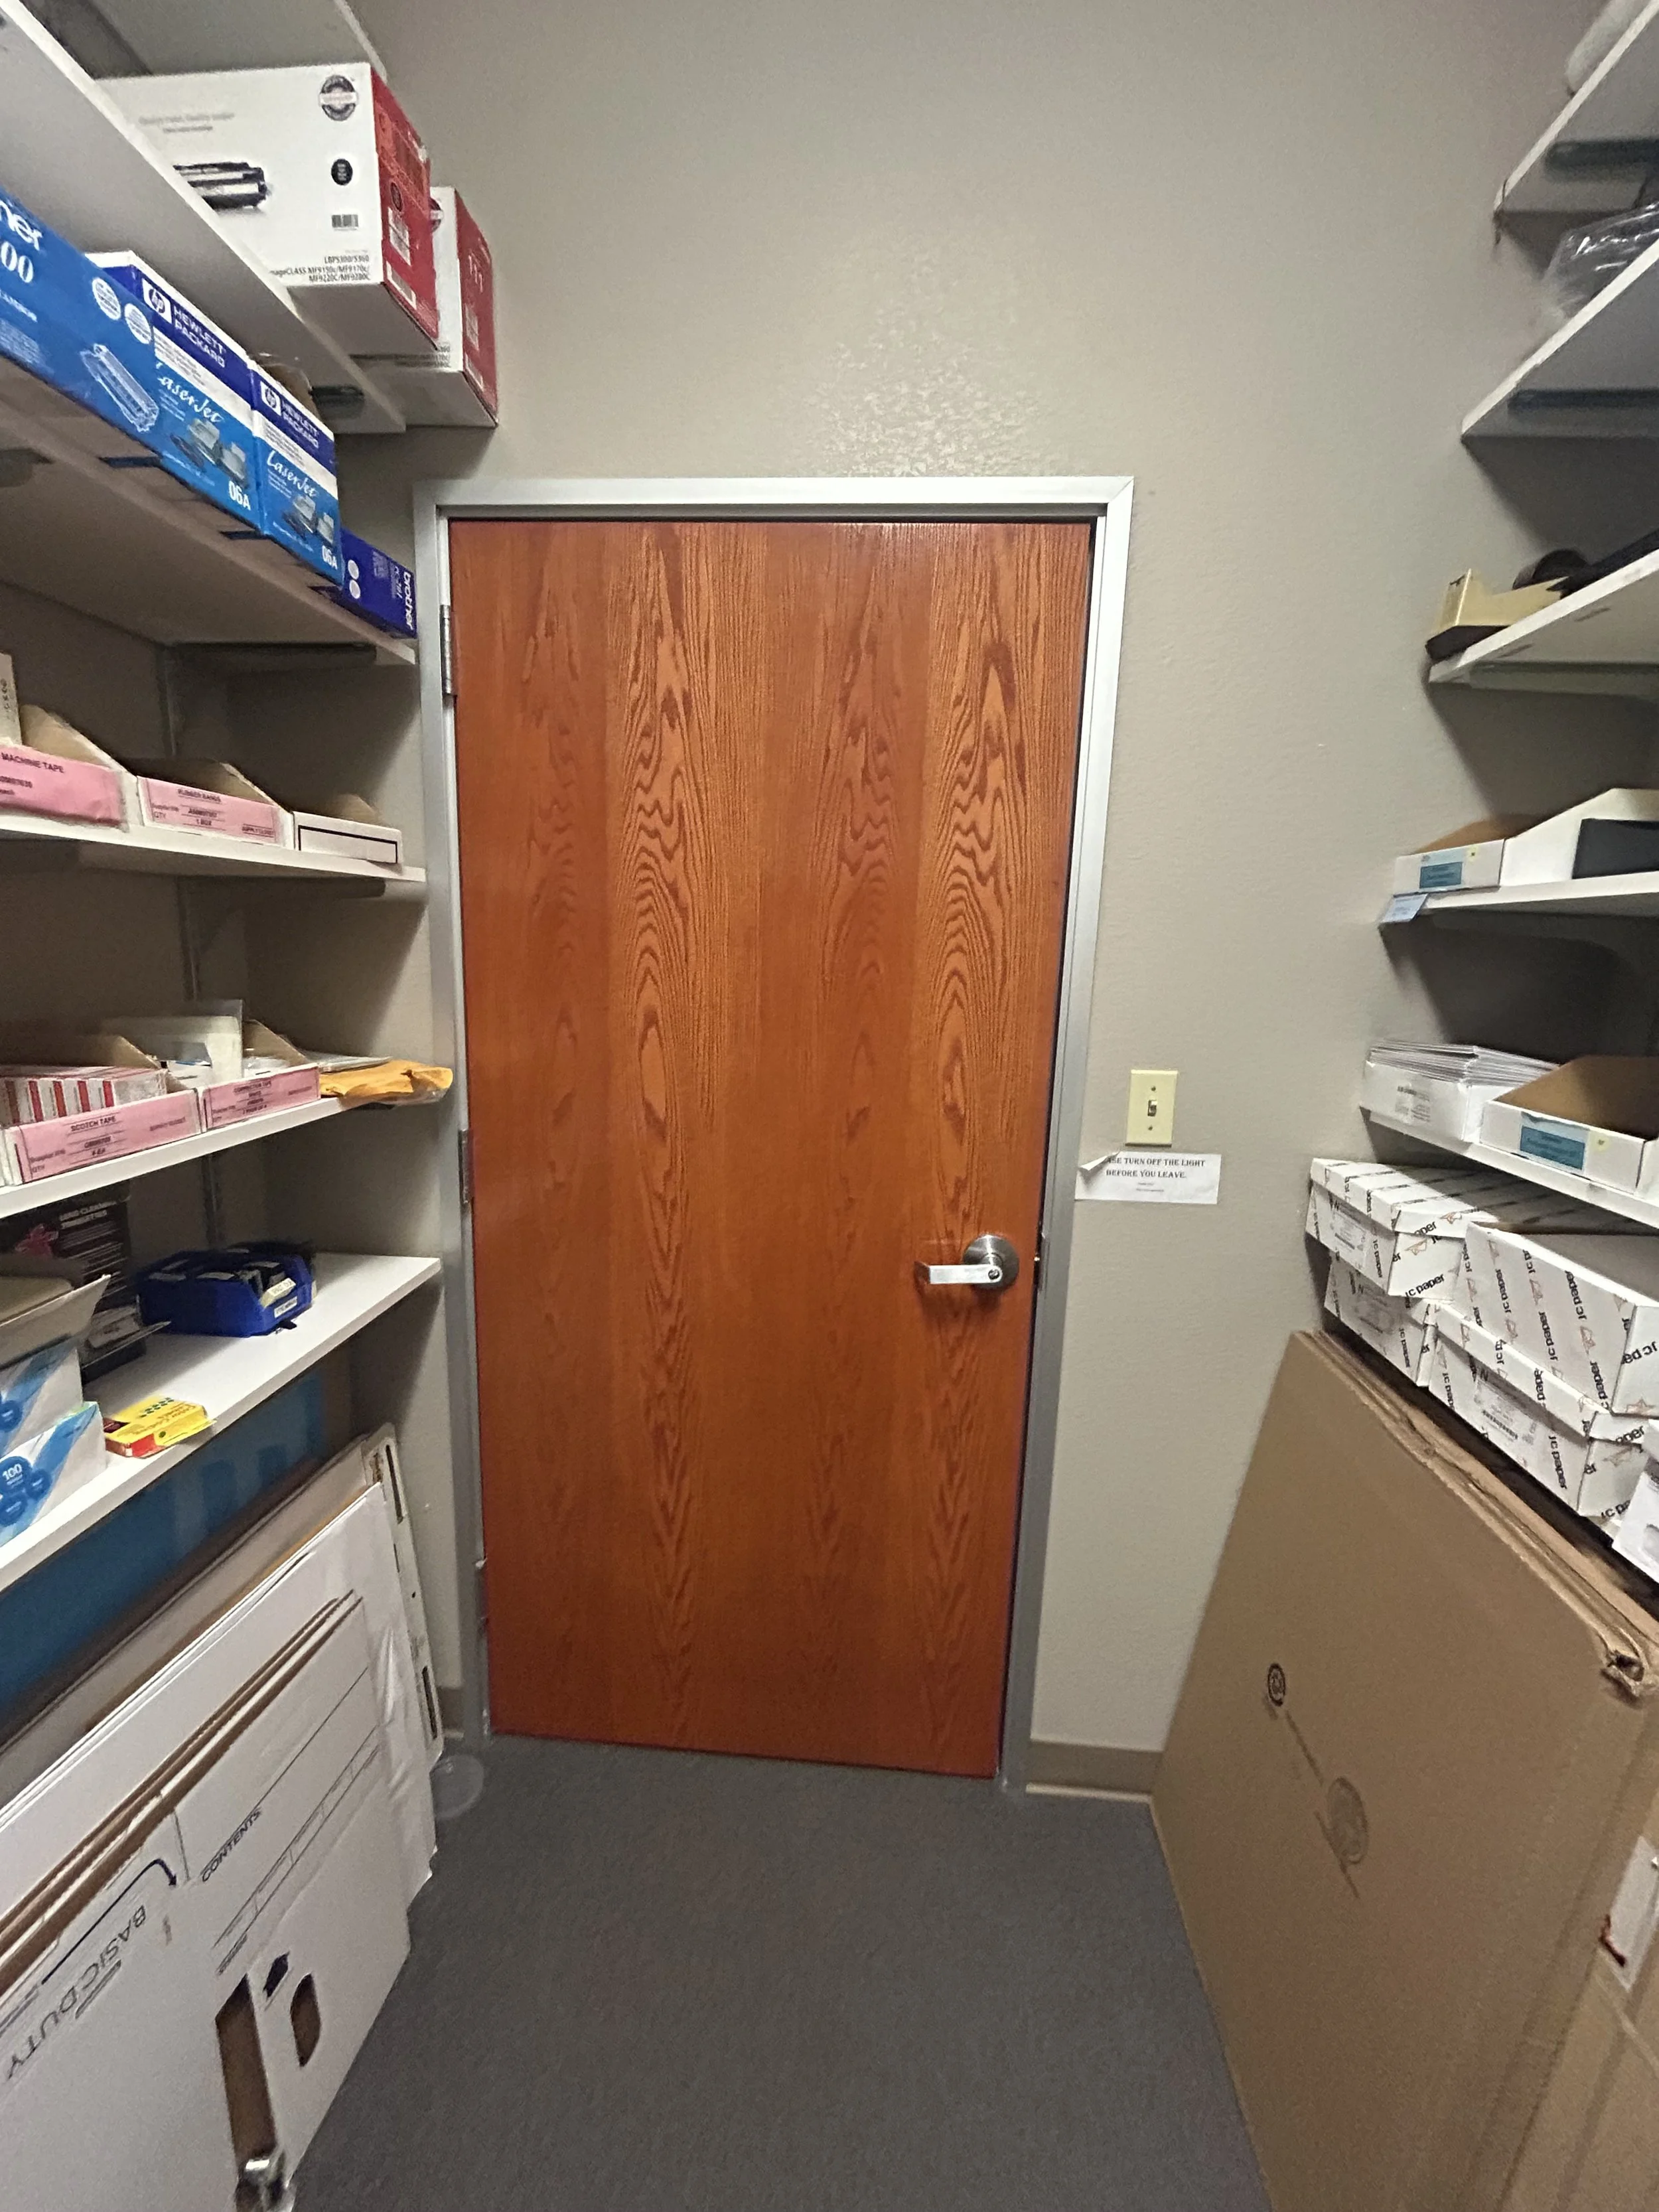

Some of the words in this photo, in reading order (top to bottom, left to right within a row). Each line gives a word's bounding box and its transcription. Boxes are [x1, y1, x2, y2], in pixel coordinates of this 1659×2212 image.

[173, 305, 225, 355] HEWLETT
[175, 320, 226, 368] PACKARD
[157, 364, 225, 423] aserJet
[267, 449, 319, 497] LaserJet
[228, 480, 252, 511] 06A
[321, 545, 338, 569] 06A
[403, 571, 414, 630] brother
[42, 761, 64, 774] TAPE
[70, 1120, 99, 1132] SCOTCH
[100, 1116, 117, 1126] TAPE
[1415, 1274, 1445, 1294] paper
[1495, 1268, 1508, 1301] paper
[1538, 1311, 1554, 1347] paper
[1590, 1361, 1609, 1400] paper
[2, 1463, 23, 1481] 100
[1551, 1451, 1567, 1489] paper
[202, 1808, 262, 1883] CONTENTS
[78, 1905, 147, 1990] BASIC
[6, 1986, 78, 2080] DUTY
